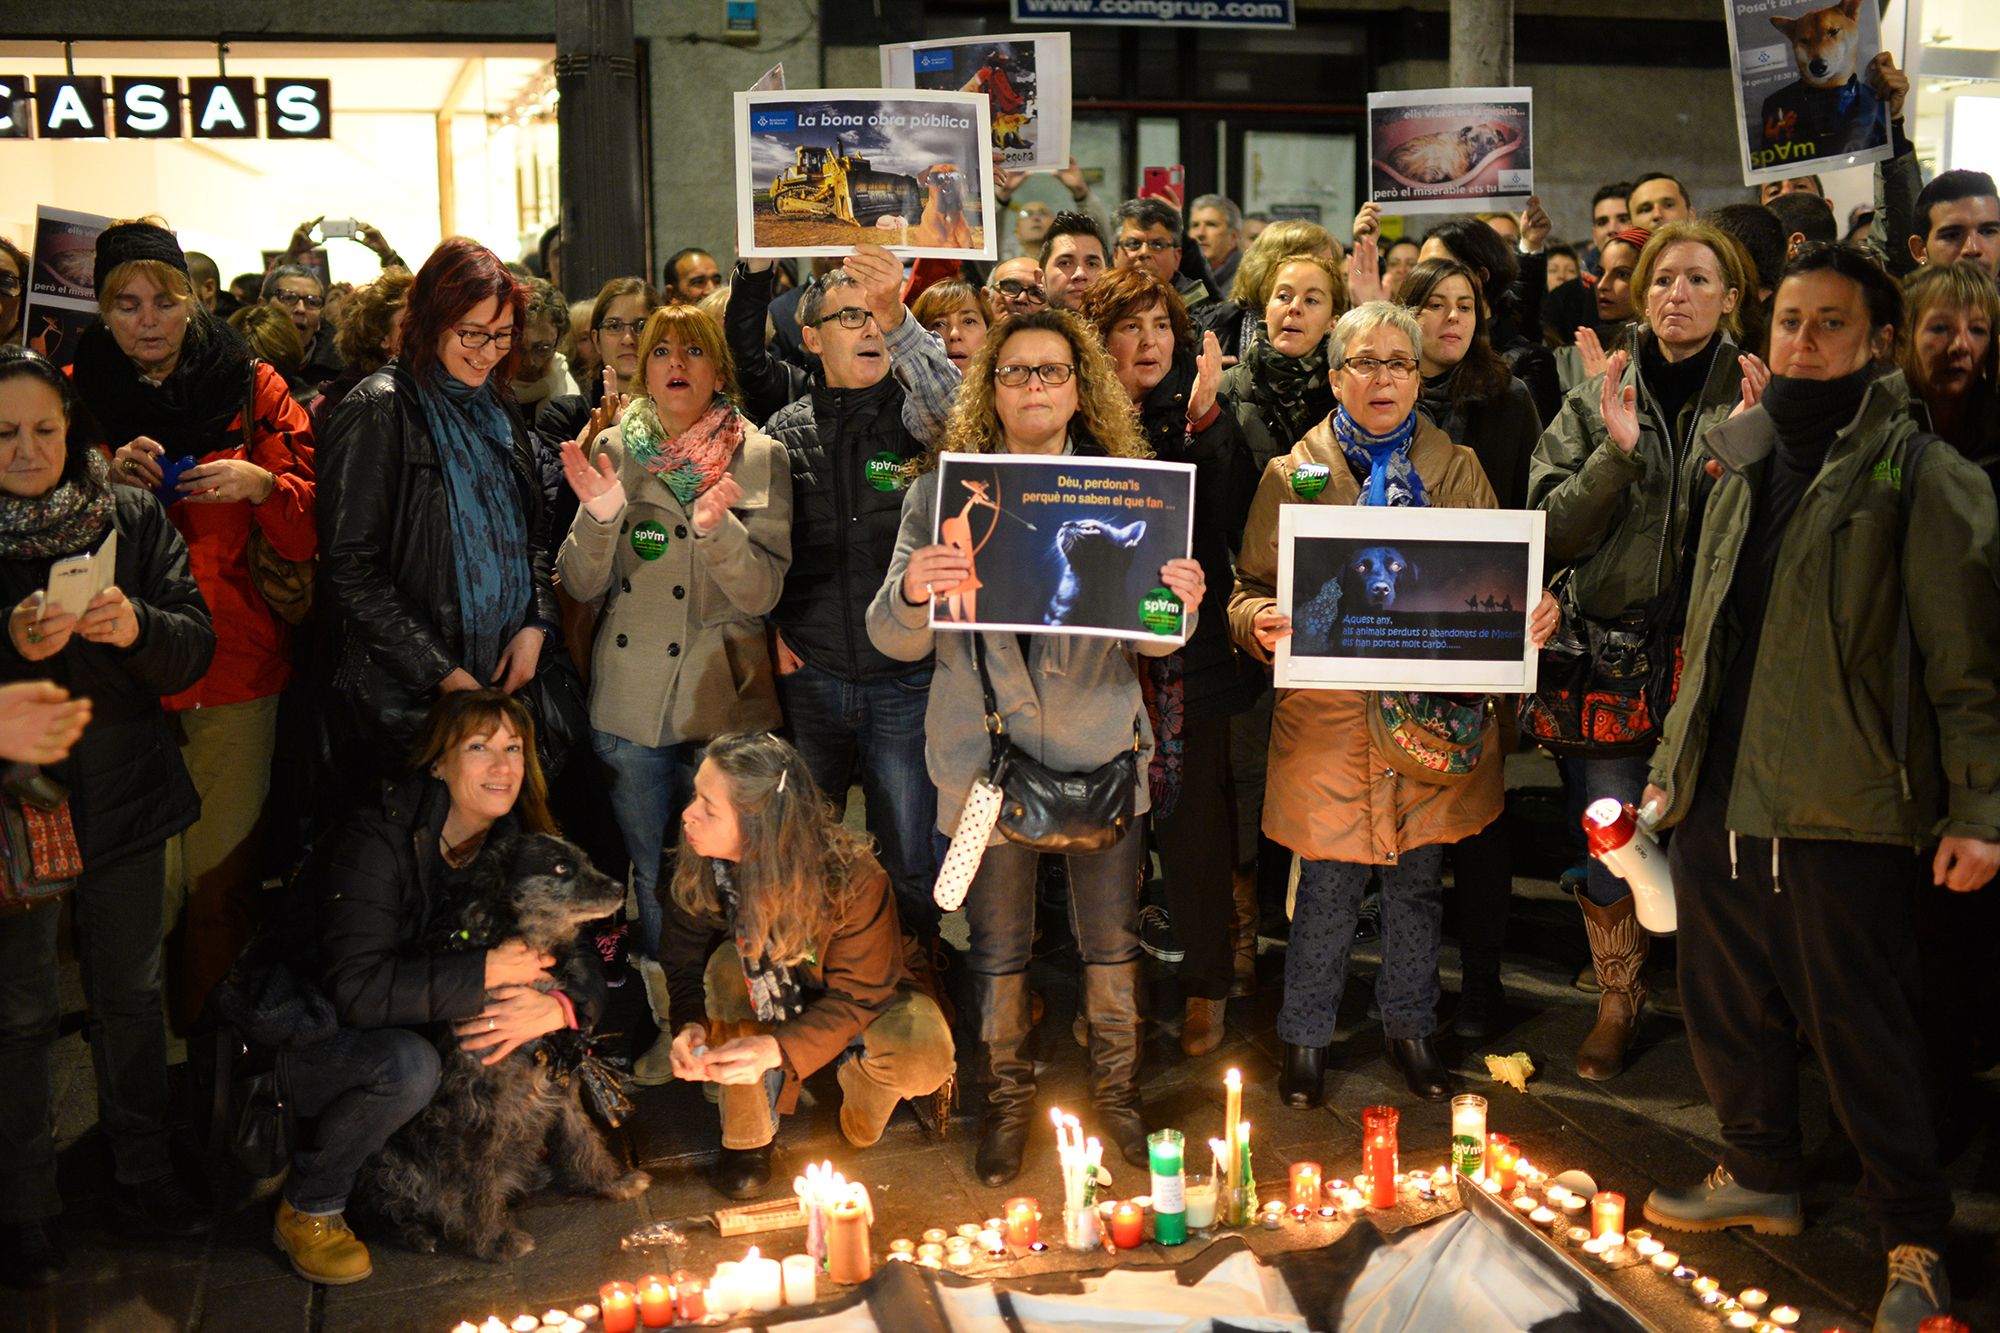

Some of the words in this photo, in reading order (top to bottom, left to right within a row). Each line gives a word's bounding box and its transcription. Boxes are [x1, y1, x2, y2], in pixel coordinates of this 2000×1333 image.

[1027, 0, 1282, 19] www.comgrup.com
[0, 84, 321, 132] ASAS
[798, 114, 816, 127] La
[821, 113, 863, 127] bona
[868, 113, 906, 127] obra
[910, 112, 969, 129] pública
[1374, 187, 1398, 201] però
[1400, 186, 1410, 197] el
[1413, 184, 1466, 197] miserable
[1486, 184, 1498, 193] tu
[34, 282, 56, 292] però
[58, 285, 67, 294] el
[1085, 477, 1140, 492] perdona'ls
[1022, 491, 1061, 505] perquè
[1062, 494, 1077, 503] no
[1078, 492, 1111, 505] saben
[1112, 494, 1123, 506] el
[1124, 496, 1145, 509] que
[1146, 496, 1164, 509] fan
[1343, 615, 1374, 626] Aquest
[1355, 626, 1386, 637] animals
[1387, 627, 1420, 638] perduts
[1429, 627, 1477, 638] abandonats
[1478, 628, 1489, 638] de
[1355, 638, 1371, 647] han
[1372, 639, 1400, 648] portat
